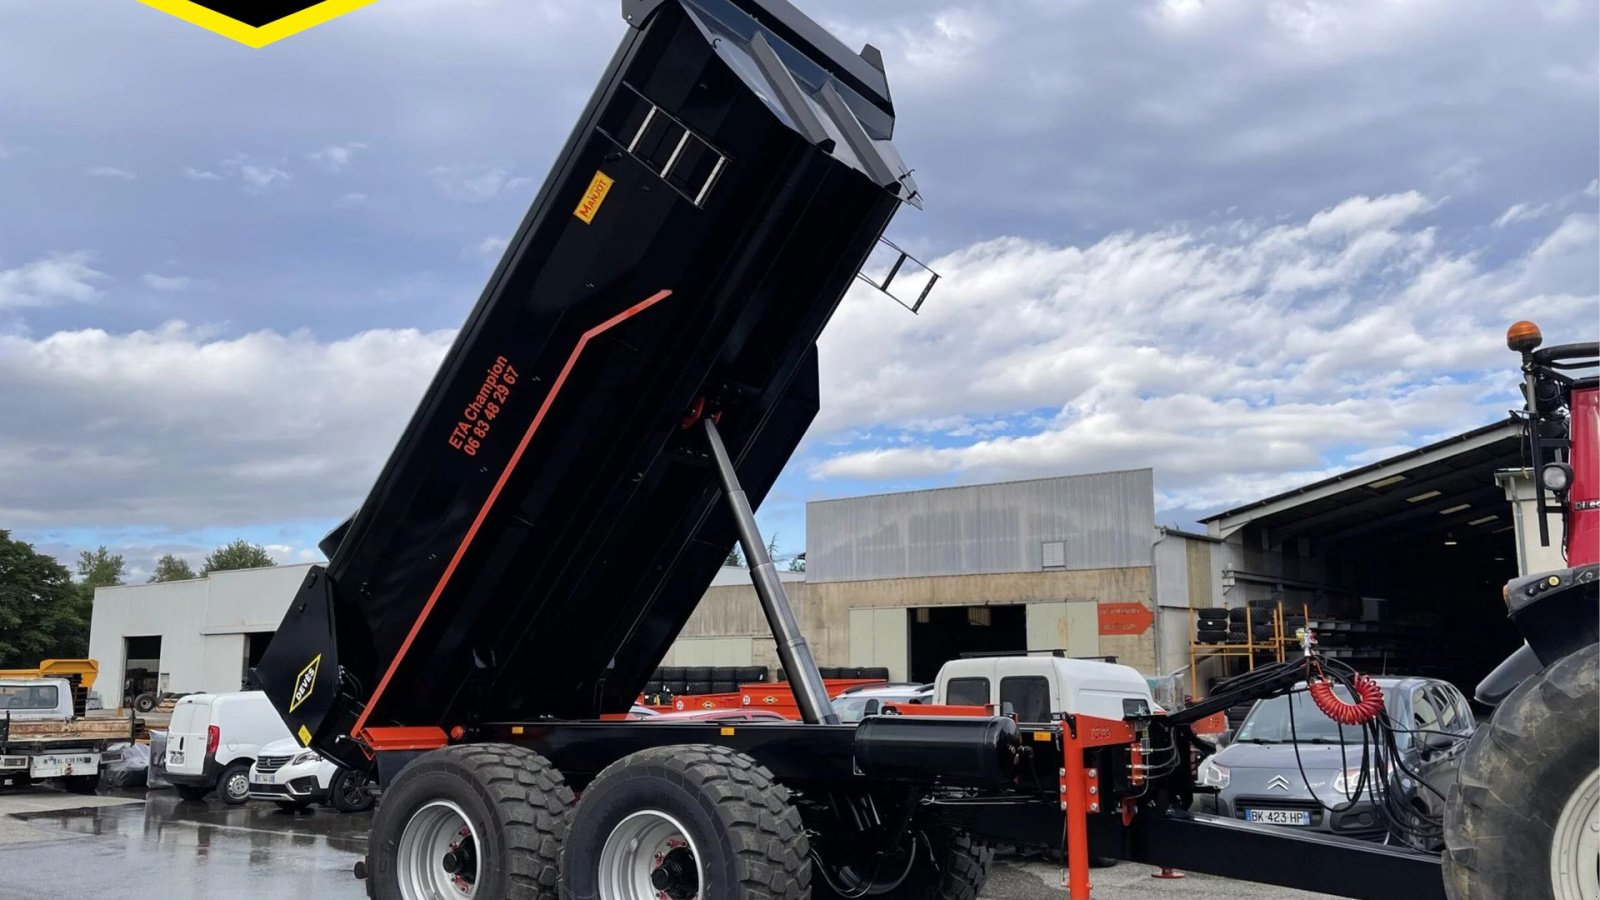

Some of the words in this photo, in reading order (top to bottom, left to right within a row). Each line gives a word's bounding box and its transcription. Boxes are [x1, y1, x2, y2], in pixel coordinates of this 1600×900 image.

[579, 179, 606, 218] MANJOT
[448, 421, 472, 450] ETA
[464, 355, 508, 421] Champion
[463, 436, 480, 456] 06
[473, 420, 490, 438] 83
[484, 402, 500, 420] 48
[493, 384, 509, 404] 29
[503, 364, 519, 385] 67
[1251, 810, 1264, 821] BK
[1267, 811, 1287, 823] 423
[1290, 813, 1303, 824] HP
